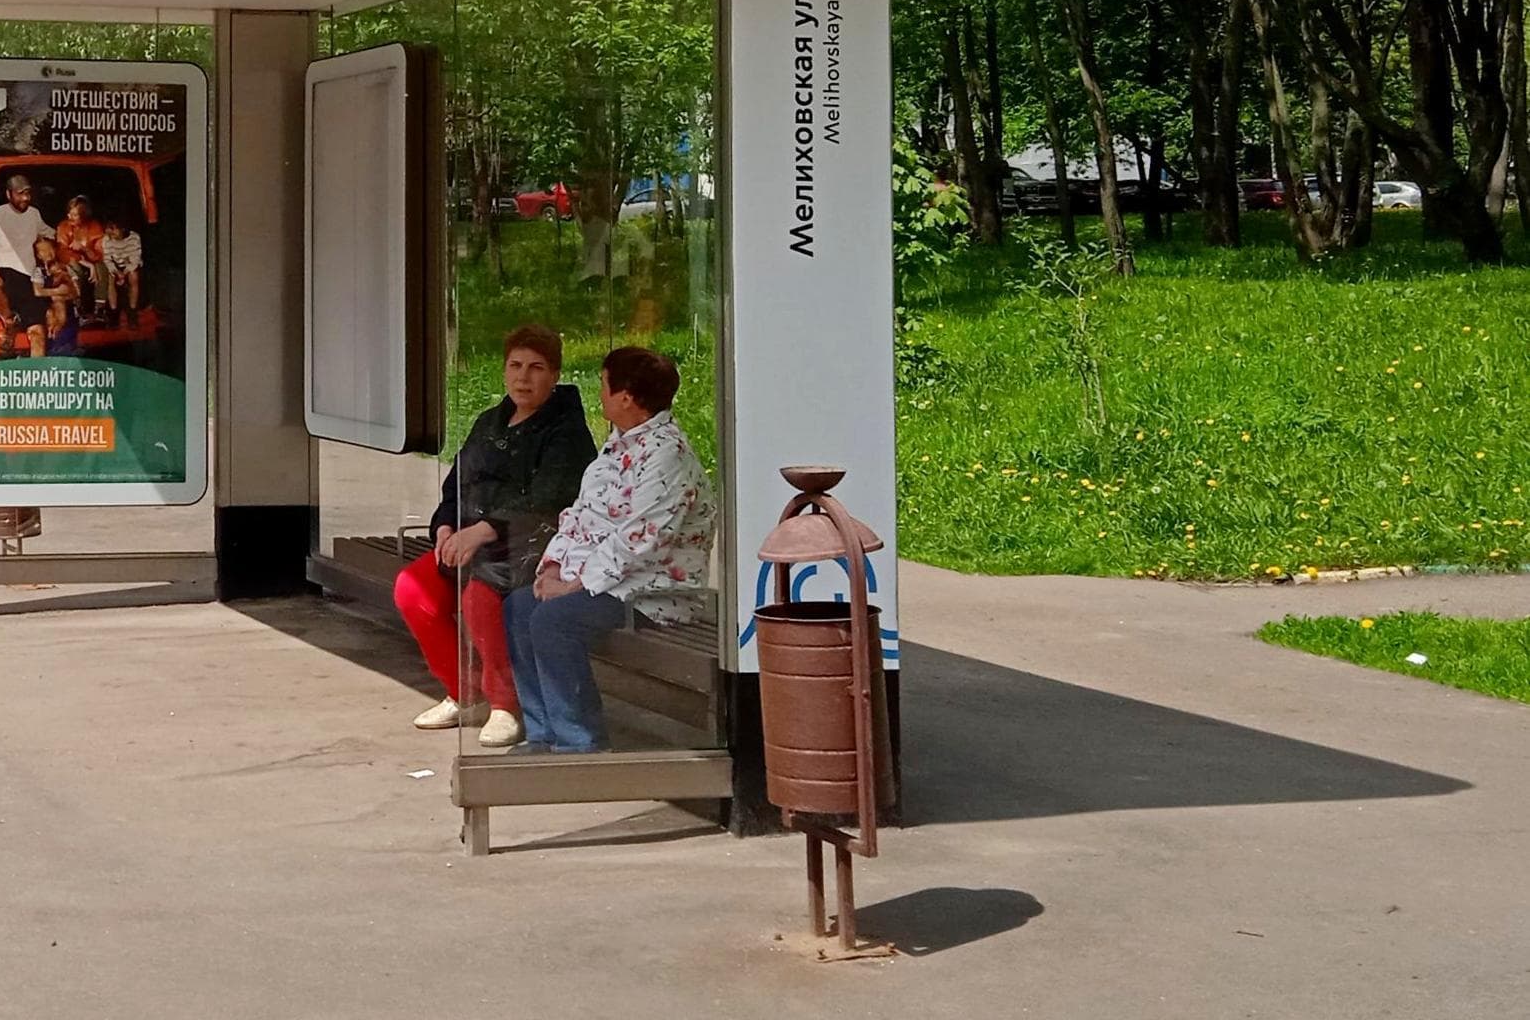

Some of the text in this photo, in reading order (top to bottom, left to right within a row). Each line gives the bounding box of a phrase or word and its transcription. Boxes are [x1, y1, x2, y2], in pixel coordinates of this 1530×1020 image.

[823, 0, 844, 144] Melihovskaya
[51, 89, 158, 111] ПУТЕШЕСТВИЯ
[50, 109, 176, 133] ЛУЧШИЙ СПОСОБ
[51, 133, 154, 154] БЫТЬ ВМЕСТЕ
[789, 35, 814, 257] Мелиховская
[78, 367, 115, 389] СВОЙ
[95, 393, 114, 410] НА
